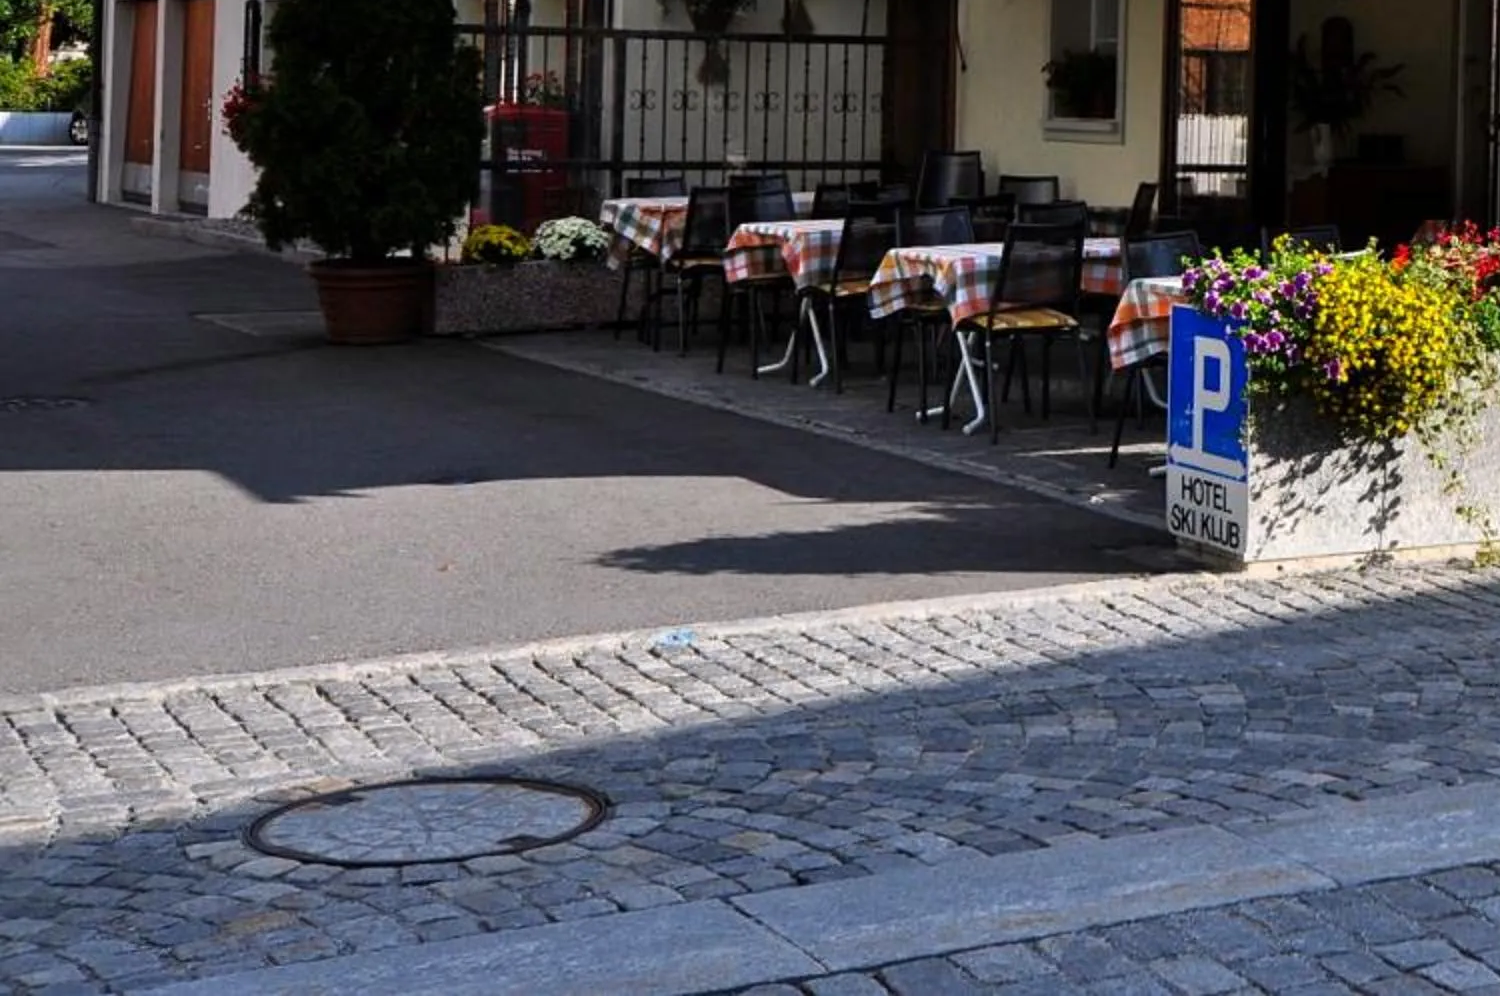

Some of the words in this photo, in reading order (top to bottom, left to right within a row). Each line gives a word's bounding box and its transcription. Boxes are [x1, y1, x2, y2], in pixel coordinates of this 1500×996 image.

[1192, 336, 1232, 454] P
[1181, 475, 1233, 515] HOTEL
[1170, 503, 1196, 537] SKI
[1201, 514, 1241, 550] KLUB
